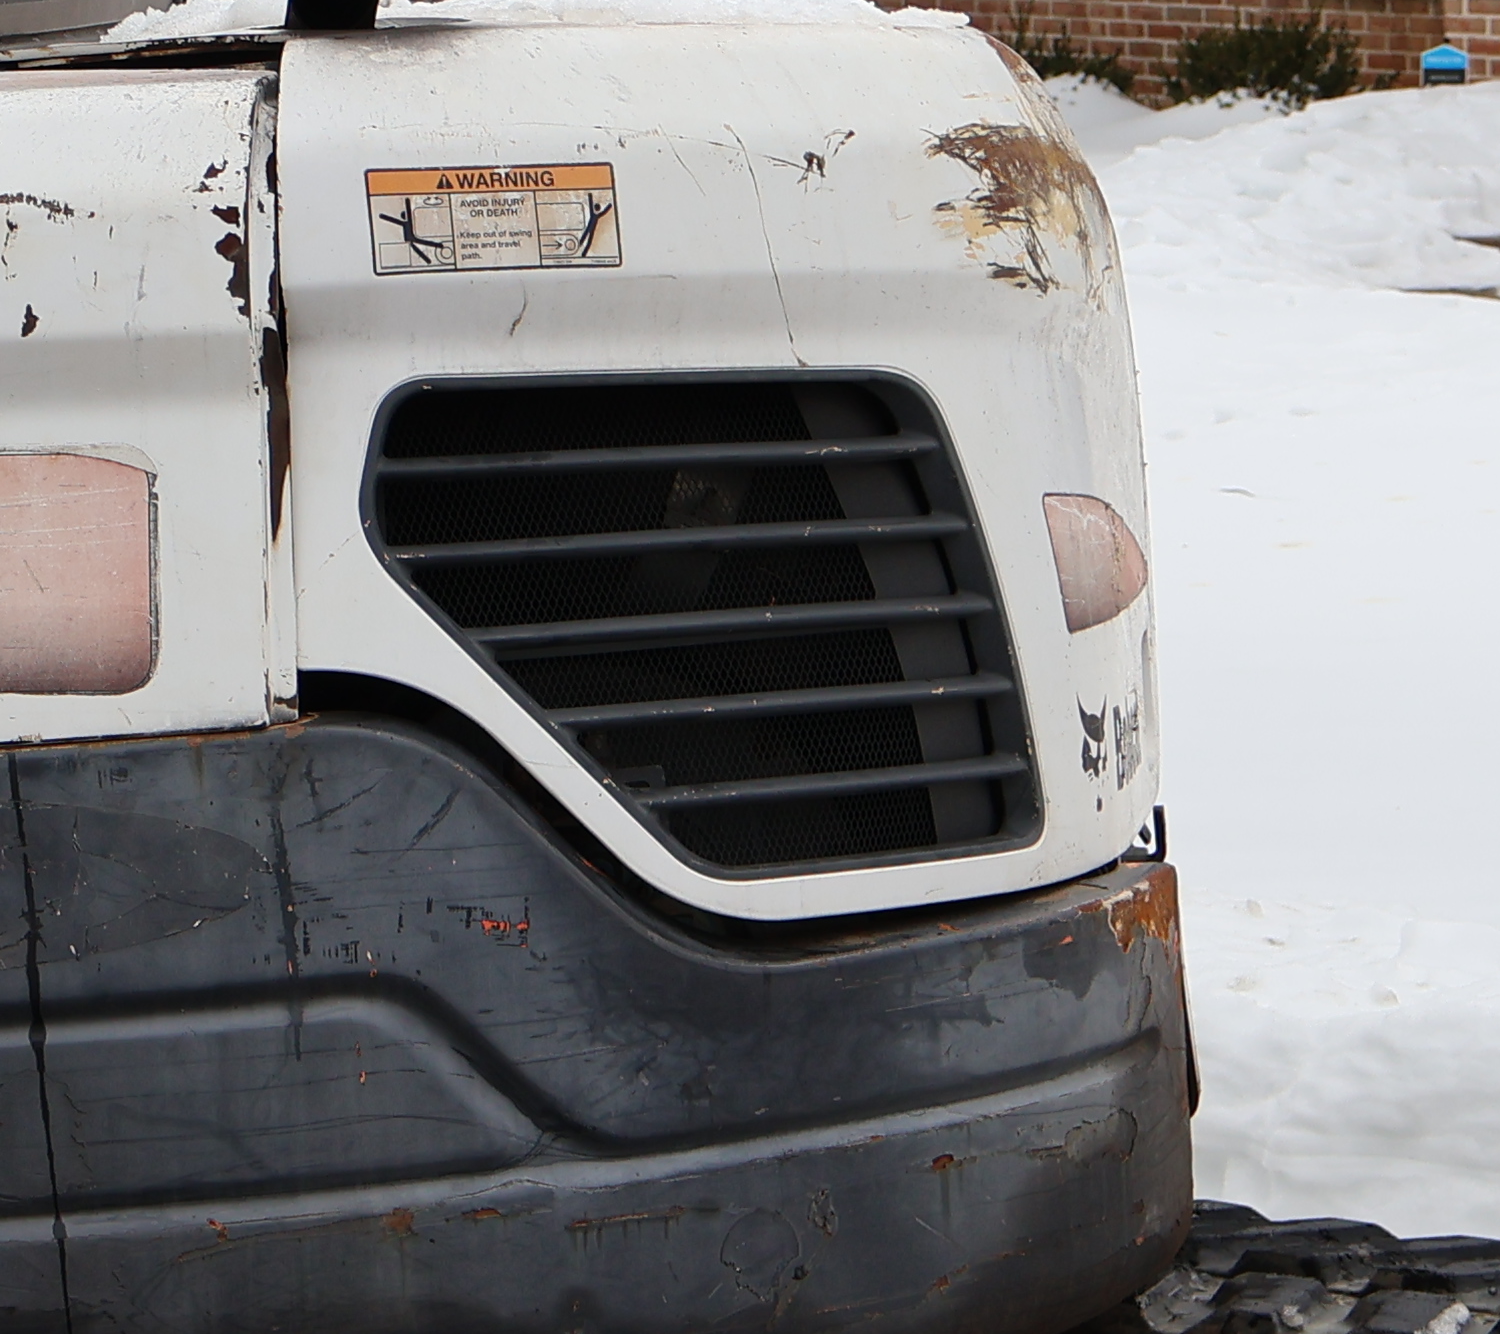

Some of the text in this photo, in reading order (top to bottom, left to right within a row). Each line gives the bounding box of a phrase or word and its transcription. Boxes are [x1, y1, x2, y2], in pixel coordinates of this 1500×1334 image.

[455, 171, 555, 189] WARNING
[460, 197, 525, 208] AVOID INJURY
[470, 208, 518, 218] OR DEATH
[460, 229, 533, 240] Keep out of swing
[461, 240, 520, 250] area and travel
